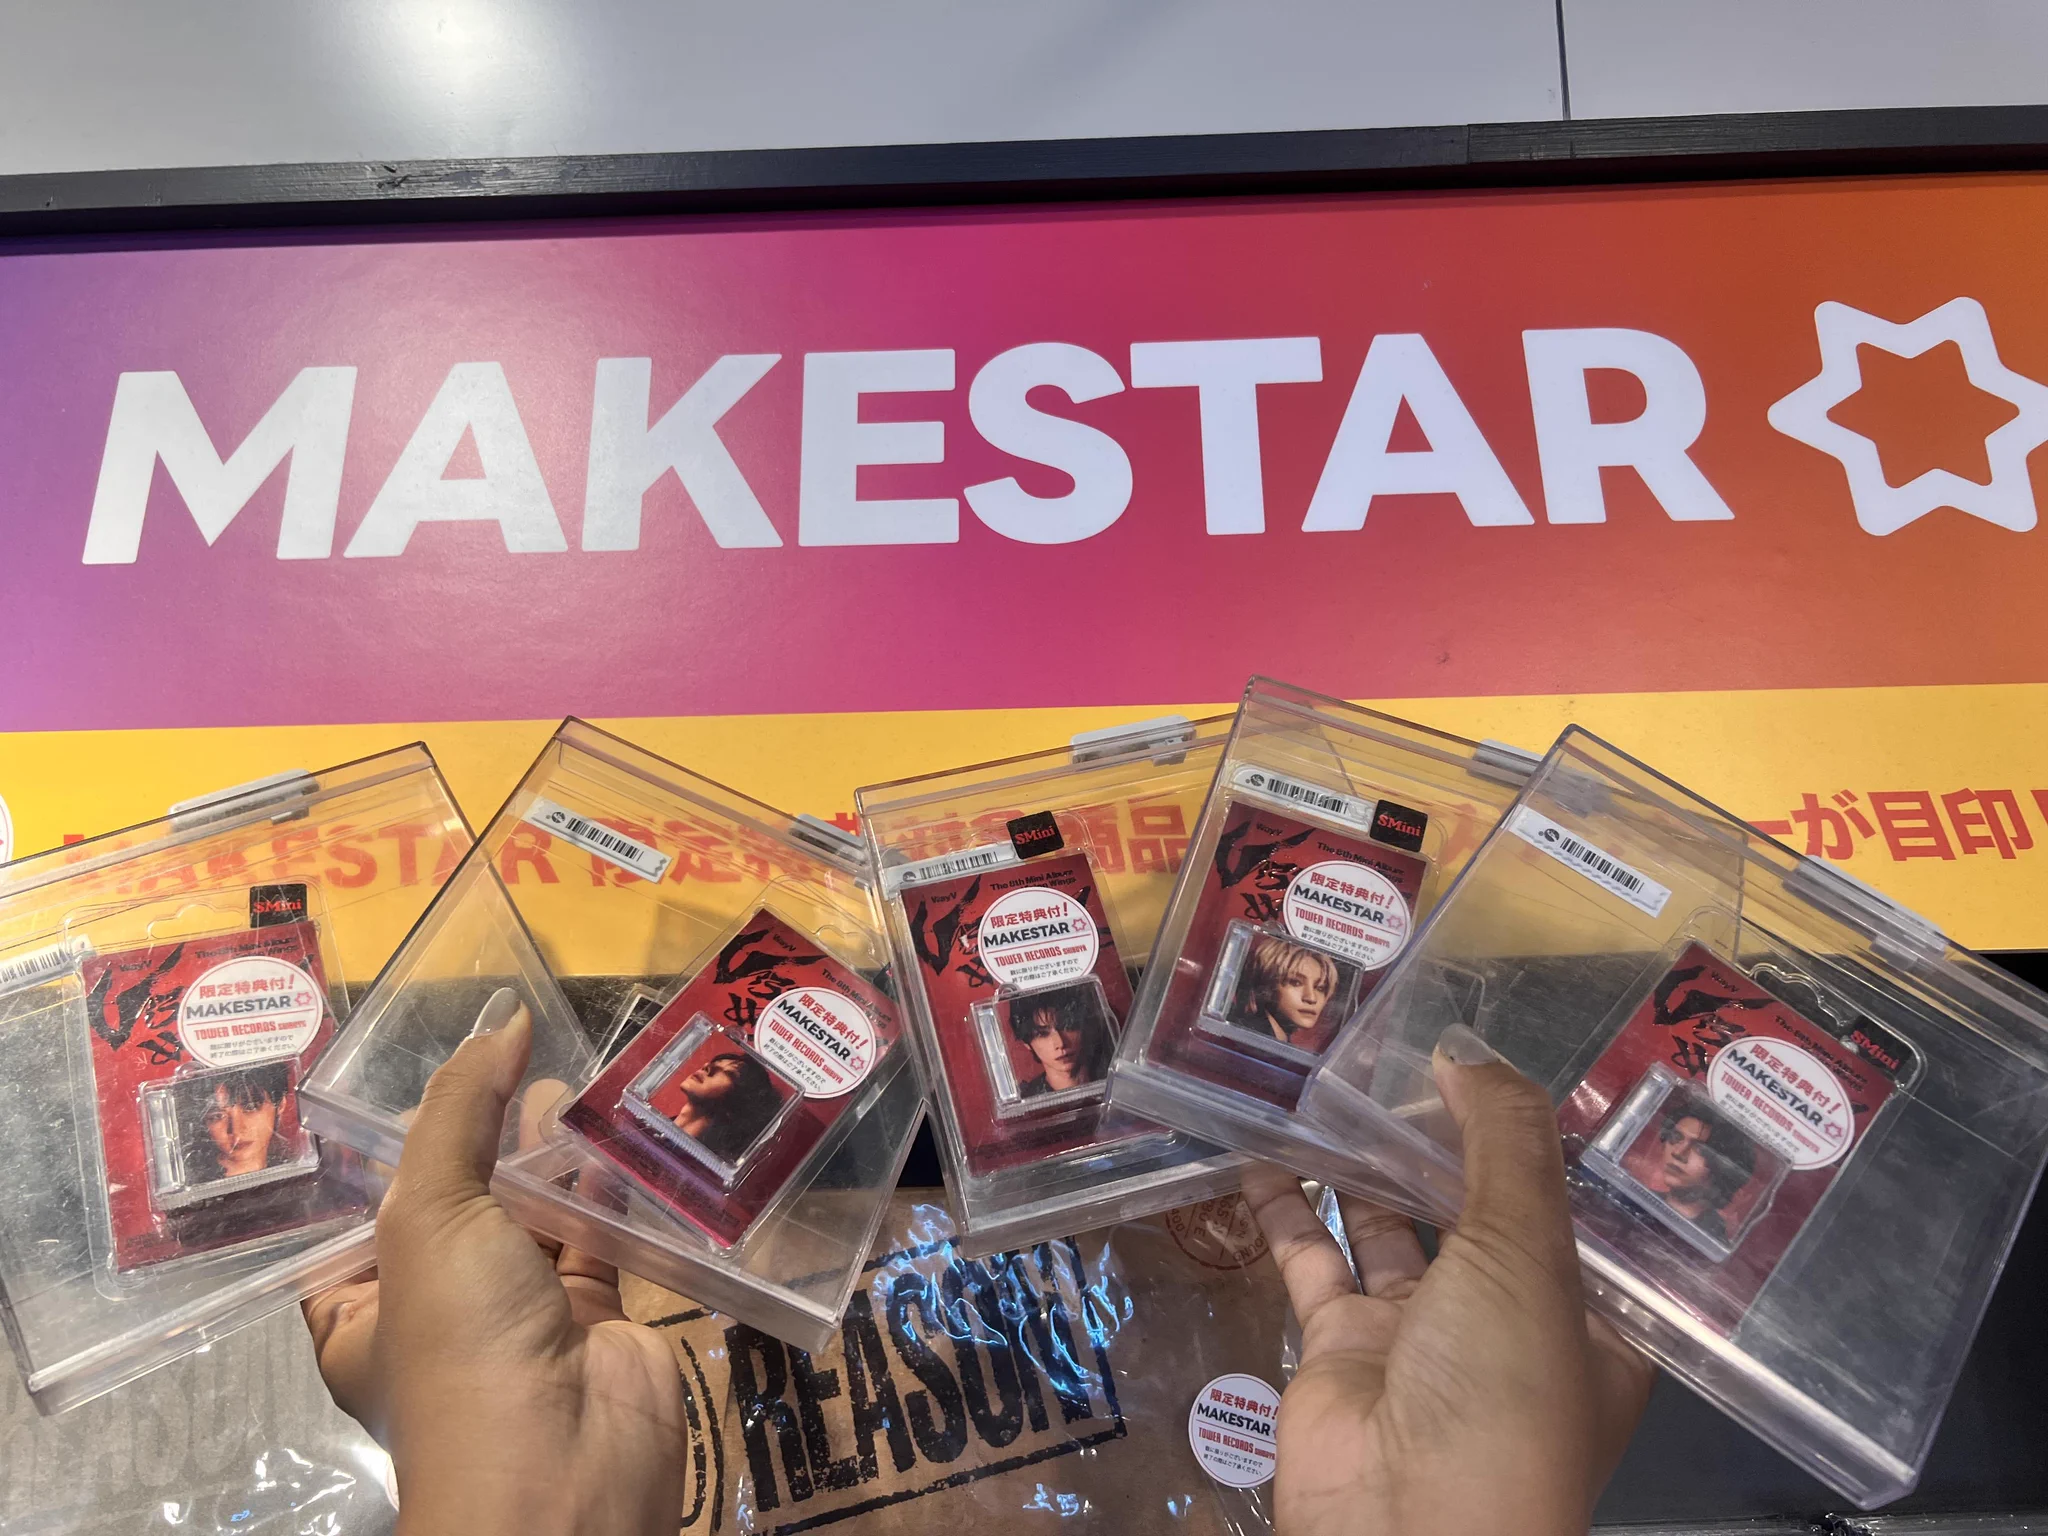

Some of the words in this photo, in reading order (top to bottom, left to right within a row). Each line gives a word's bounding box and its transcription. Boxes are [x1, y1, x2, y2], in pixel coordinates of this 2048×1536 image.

[82, 326, 1735, 565] MAKESTAR
[1015, 826, 1055, 845] SMini
[1378, 813, 1422, 837] SMini
[990, 884, 1008, 892] The
[1026, 874, 1044, 885] Mini
[1310, 871, 1394, 909] 限定特典付!
[252, 898, 302, 913] SMini
[990, 902, 1068, 929] 限定特典付!
[1294, 884, 1384, 924] MAKESTAR
[983, 922, 1070, 948] MAKESTAR
[1295, 907, 1323, 925] TOWER
[1326, 918, 1364, 939] RECORDS
[994, 954, 1024, 967] TOWER
[1024, 946, 1062, 962] RECORDS
[1062, 944, 1087, 955] SHIBUYA
[199, 974, 294, 999] 限定特典付!
[186, 995, 291, 1019] MAKESTAR
[799, 993, 868, 1049] 限定特典付!
[194, 1026, 229, 1041] TOWER
[232, 1021, 276, 1036] RECORDS
[777, 999, 851, 1060] MAKESTAR
[768, 1019, 791, 1042] TOWER
[792, 1034, 825, 1067] RECORDS
[822, 1064, 844, 1084] SHIBUYA
[1850, 1030, 1899, 1069] SMini
[1727, 1049, 1823, 1126] MAKESTAR
[1751, 1043, 1842, 1114] 限定特典付!
[1721, 1071, 1752, 1101] TOWER
[1751, 1095, 1793, 1132] RECORDS
[1197, 1403, 1270, 1436] MAKESTAR
[1210, 1388, 1278, 1420] 限定特典付!
[1198, 1427, 1221, 1443] TOWER
[1223, 1434, 1254, 1453] RECORDS
